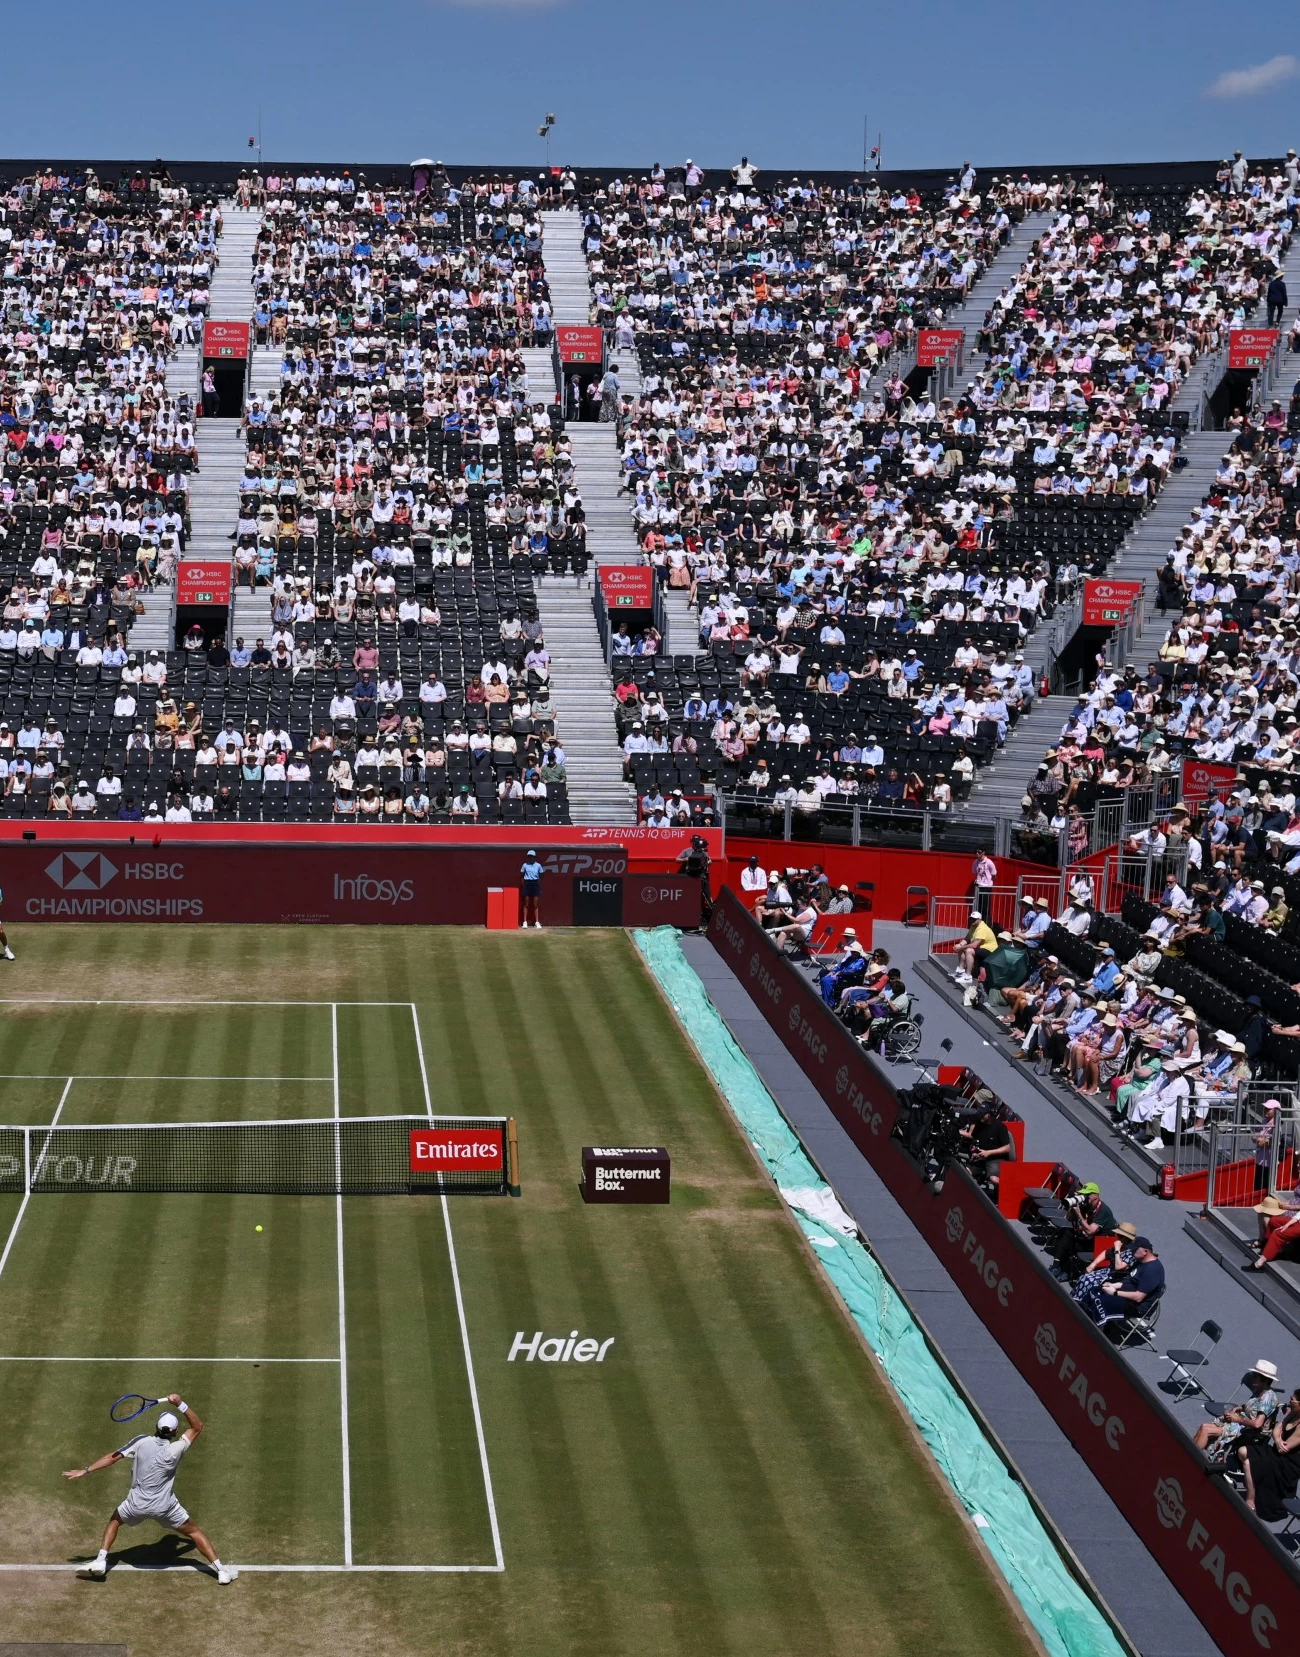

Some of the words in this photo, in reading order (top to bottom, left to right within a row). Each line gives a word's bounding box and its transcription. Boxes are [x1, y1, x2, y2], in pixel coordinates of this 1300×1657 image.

[580, 828, 607, 838] ATP
[608, 828, 645, 838] TENNIS
[647, 828, 659, 839] IQ
[671, 830, 685, 838] PIF
[124, 863, 184, 880] HSBC
[542, 855, 592, 874] ATP
[592, 859, 626, 875] 500
[333, 873, 414, 905] Infosys
[579, 881, 617, 893] Haier
[660, 889, 683, 900] PIF
[26, 898, 204, 917] CHAMPIONSHIPS
[723, 920, 744, 954] FAGE
[757, 965, 782, 1004] FAGE
[799, 1018, 828, 1064] FAGE
[847, 1082, 883, 1135] FAGE
[415, 1140, 498, 1159] Emirates
[34, 1155, 137, 1185] TOUR
[595, 1166, 661, 1179] Butternut
[595, 1179, 625, 1190] Box.
[962, 1230, 1014, 1307] FAGE
[1094, 1298, 1106, 1318] CLUB
[507, 1330, 615, 1361] Haier
[1058, 1353, 1126, 1450] FAGE
[1157, 1486, 1182, 1521] FAGE
[1186, 1518, 1278, 1649] FAGE
